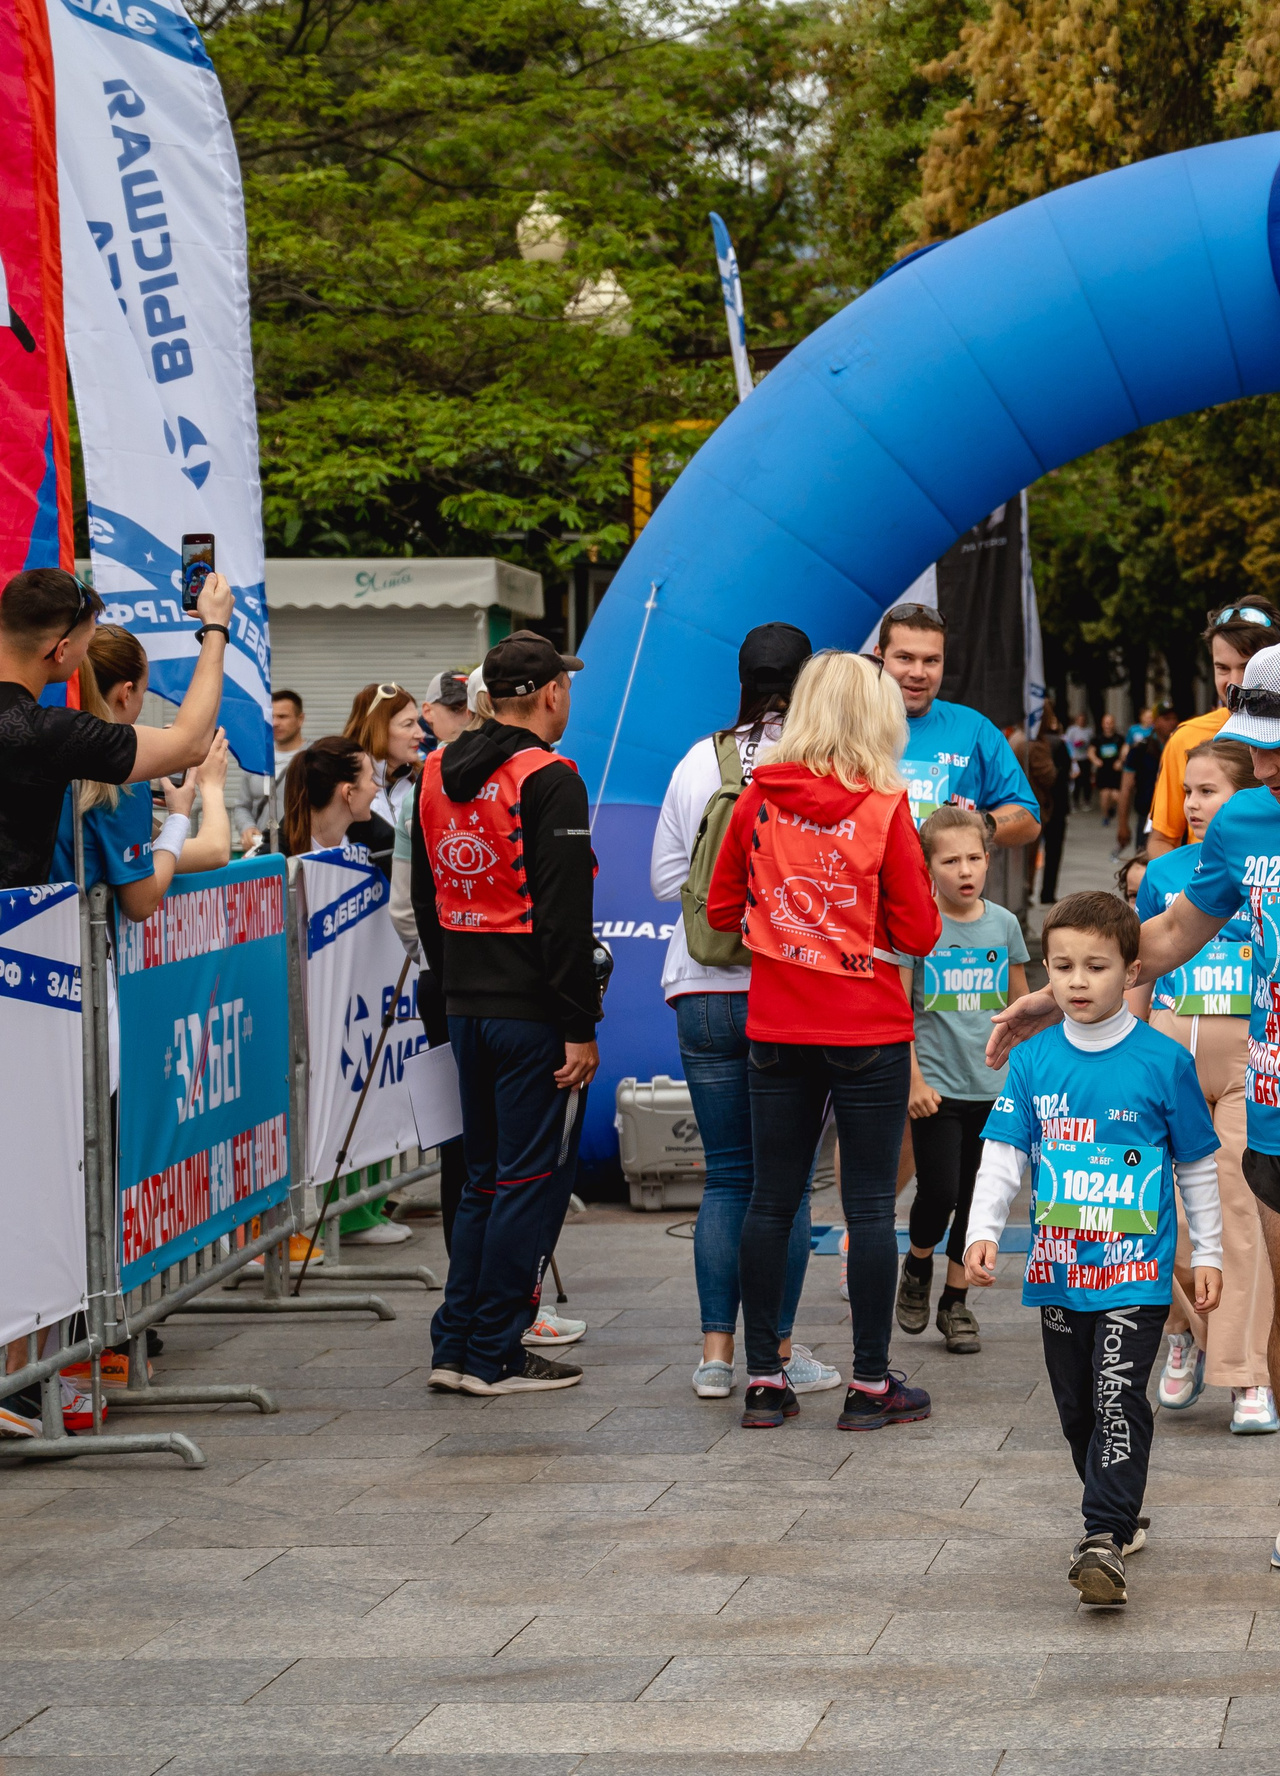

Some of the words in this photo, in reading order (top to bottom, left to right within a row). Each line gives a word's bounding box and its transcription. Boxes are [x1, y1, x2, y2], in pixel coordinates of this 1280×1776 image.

[943, 967, 994, 991] 10072
[1193, 966, 1243, 992] 10141
[1033, 1092, 1070, 1120] 2024
[1058, 1143, 1077, 1152] ПСБ
[1062, 1169, 1135, 1206] 10244
[122, 1149, 210, 1267] #АДРЕНАЛИН
[1102, 1238, 1145, 1267] 2024
[1066, 1258, 1160, 1291] #ЕДИНСТВО
[1043, 1319, 1073, 1335] FREEDOM
[1102, 1324, 1124, 1366] FOR
[1099, 1360, 1135, 1466] VENDETTA
